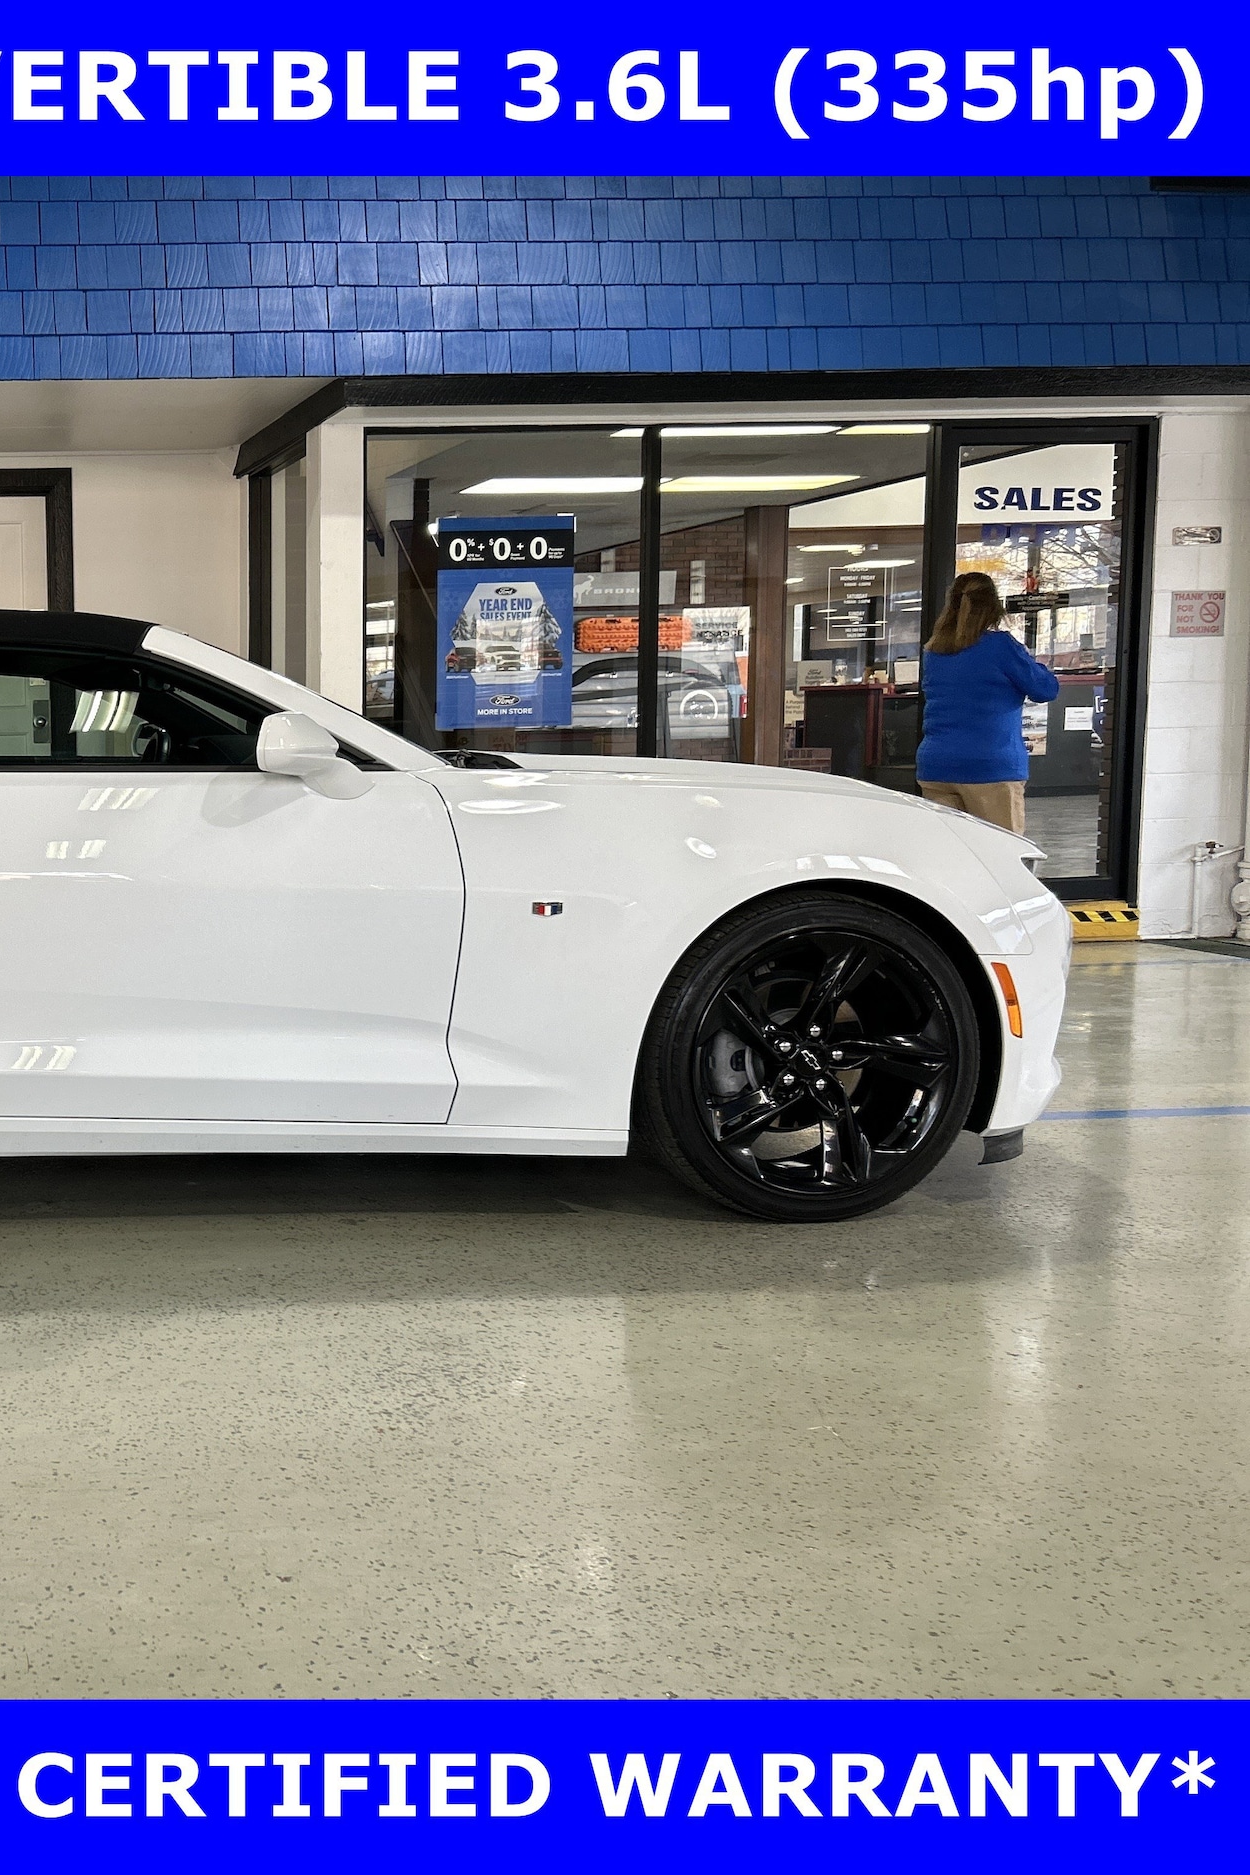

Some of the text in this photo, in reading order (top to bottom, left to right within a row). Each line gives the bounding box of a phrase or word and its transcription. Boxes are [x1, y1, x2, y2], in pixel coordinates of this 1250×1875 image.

[973, 486, 1102, 512] SALES
[529, 536, 547, 560] 0
[593, 587, 640, 595] BRON
[1174, 592, 1225, 601] THANK YOU
[479, 598, 532, 612] YEAR END
[1177, 604, 1194, 613] FOR
[480, 611, 532, 621] SALES EVENT
[1176, 615, 1195, 623] NOT
[695, 621, 739, 630] SERVICE
[1176, 625, 1220, 634] SMOKING!
[494, 695, 515, 705] Ford
[477, 708, 499, 716] MORE
